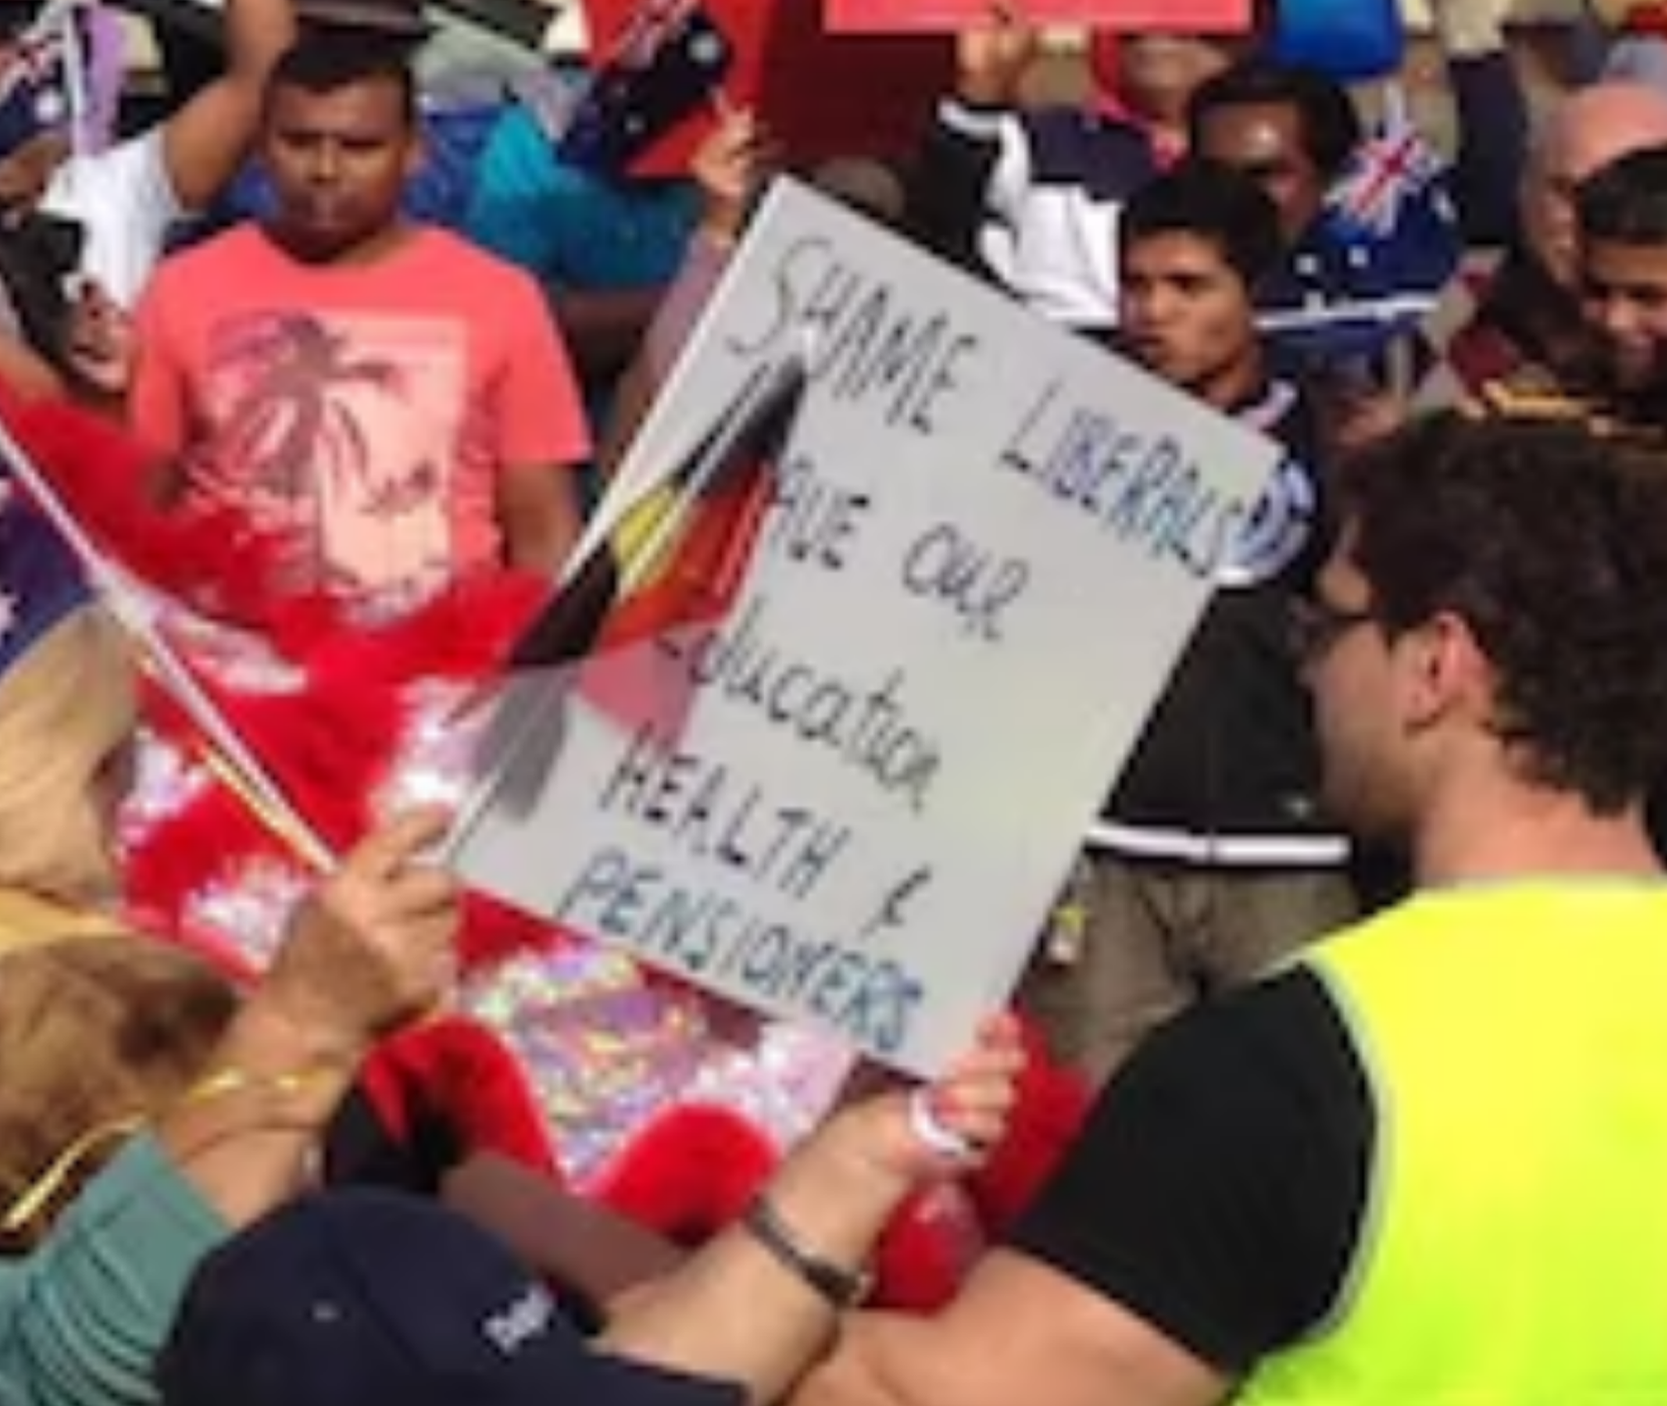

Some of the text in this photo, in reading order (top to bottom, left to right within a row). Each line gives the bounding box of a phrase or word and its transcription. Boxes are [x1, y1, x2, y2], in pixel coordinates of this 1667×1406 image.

[725, 234, 1246, 579] SHAME LIBERALS
[600, 720, 853, 902] HEALTH
[554, 846, 925, 1056] PENSIONERS
